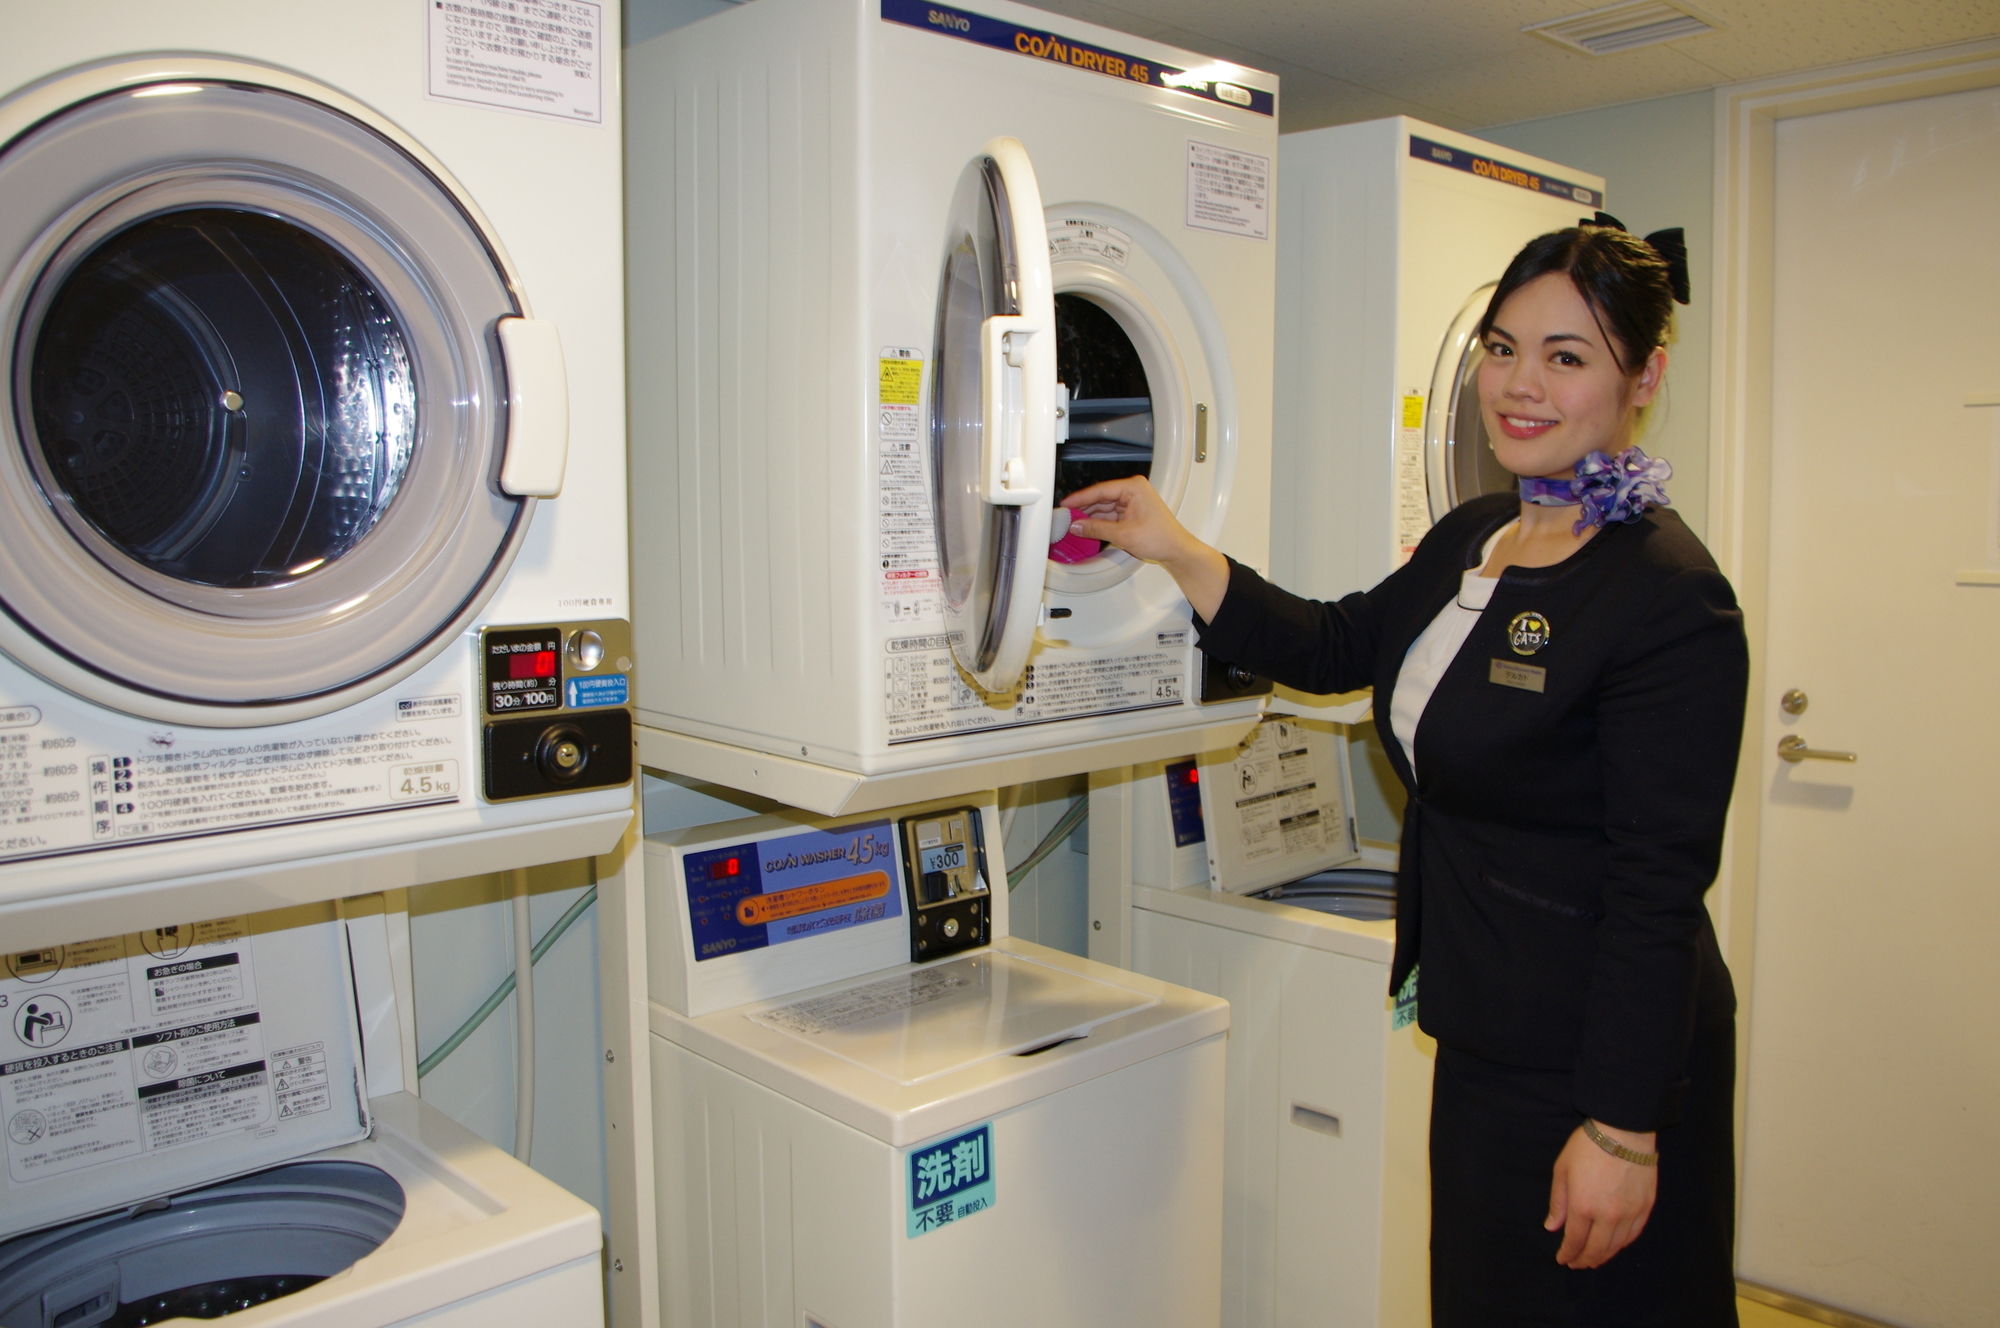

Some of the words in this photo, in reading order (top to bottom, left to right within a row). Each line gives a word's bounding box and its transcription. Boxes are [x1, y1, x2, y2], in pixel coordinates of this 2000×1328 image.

[928, 10, 970, 32] SANYO
[1071, 47, 1127, 78] DRYER
[1129, 62, 1149, 83] 45
[1500, 167, 1528, 187] DRYER
[547, 641, 556, 650] 円
[1514, 631, 1542, 646] CATS
[536, 651, 549, 675] 0
[1156, 685, 1172, 699] 4.5
[401, 776, 433, 795] 4.5
[436, 781, 451, 793] kg
[800, 846, 847, 866] WASHER
[702, 938, 738, 954] SANYO
[154, 961, 202, 977] お急ぎの場合
[156, 1019, 236, 1042] ソフト剤のご使用方法
[917, 1134, 985, 1200] 洗剤
[916, 1200, 954, 1232] 不要
[957, 1197, 988, 1219] 自動投入
